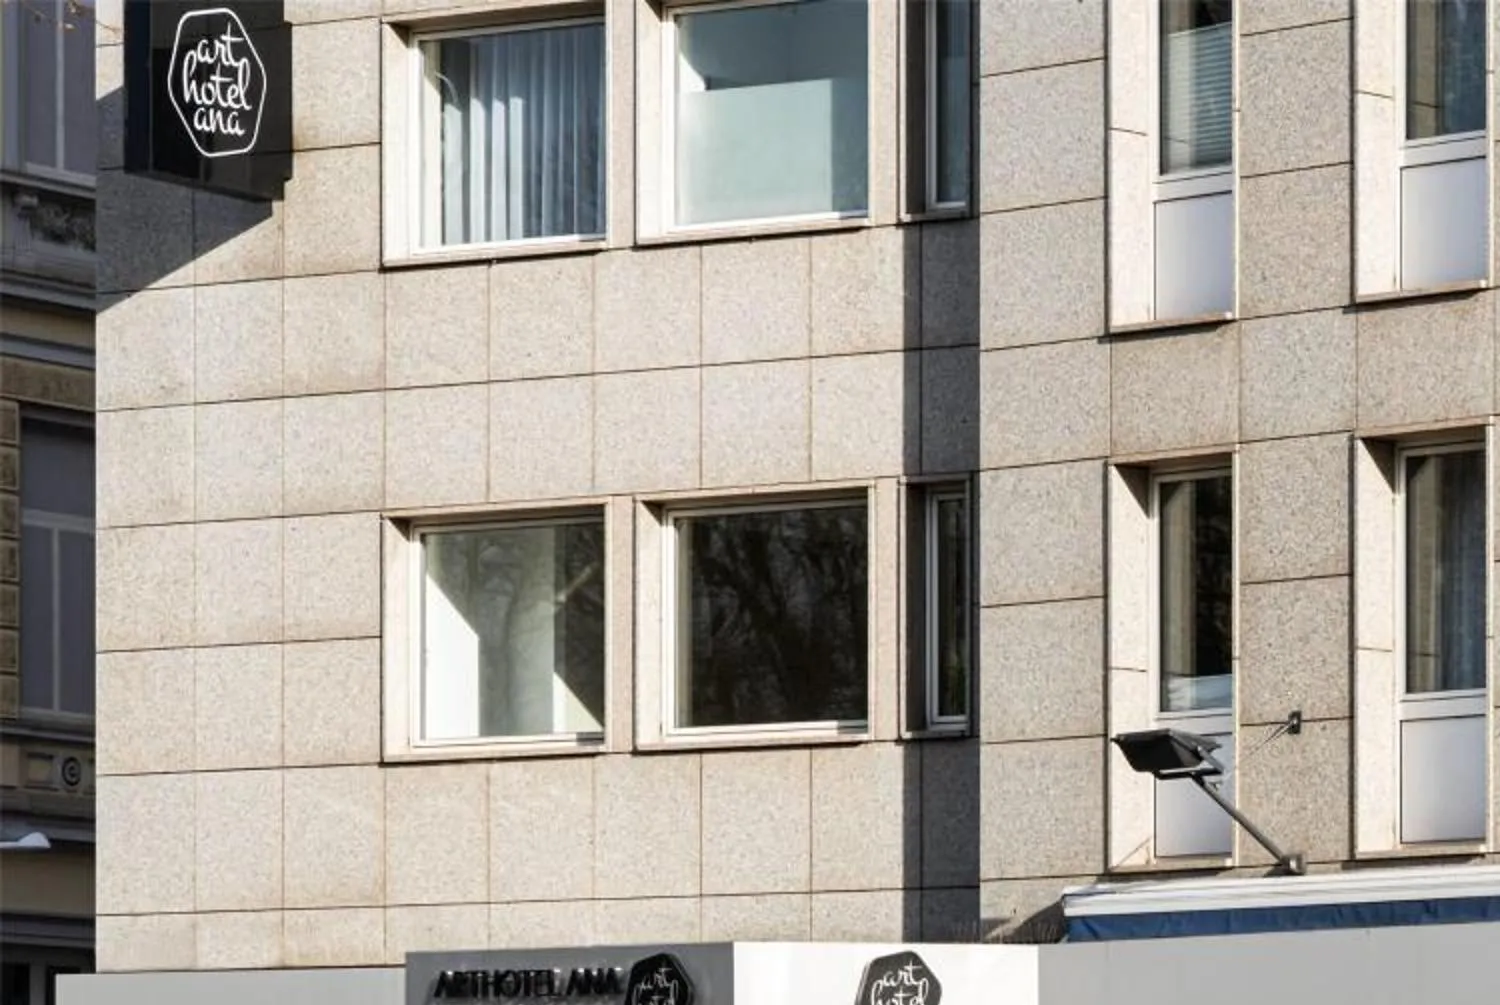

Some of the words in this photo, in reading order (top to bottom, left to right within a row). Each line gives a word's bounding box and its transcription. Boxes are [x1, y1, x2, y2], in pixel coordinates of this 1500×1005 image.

[196, 21, 244, 67] art
[182, 49, 252, 111] hotel
[193, 107, 245, 136] ana
[566, 967, 625, 996] ANA
[641, 962, 673, 990] art
[883, 960, 922, 986] art
